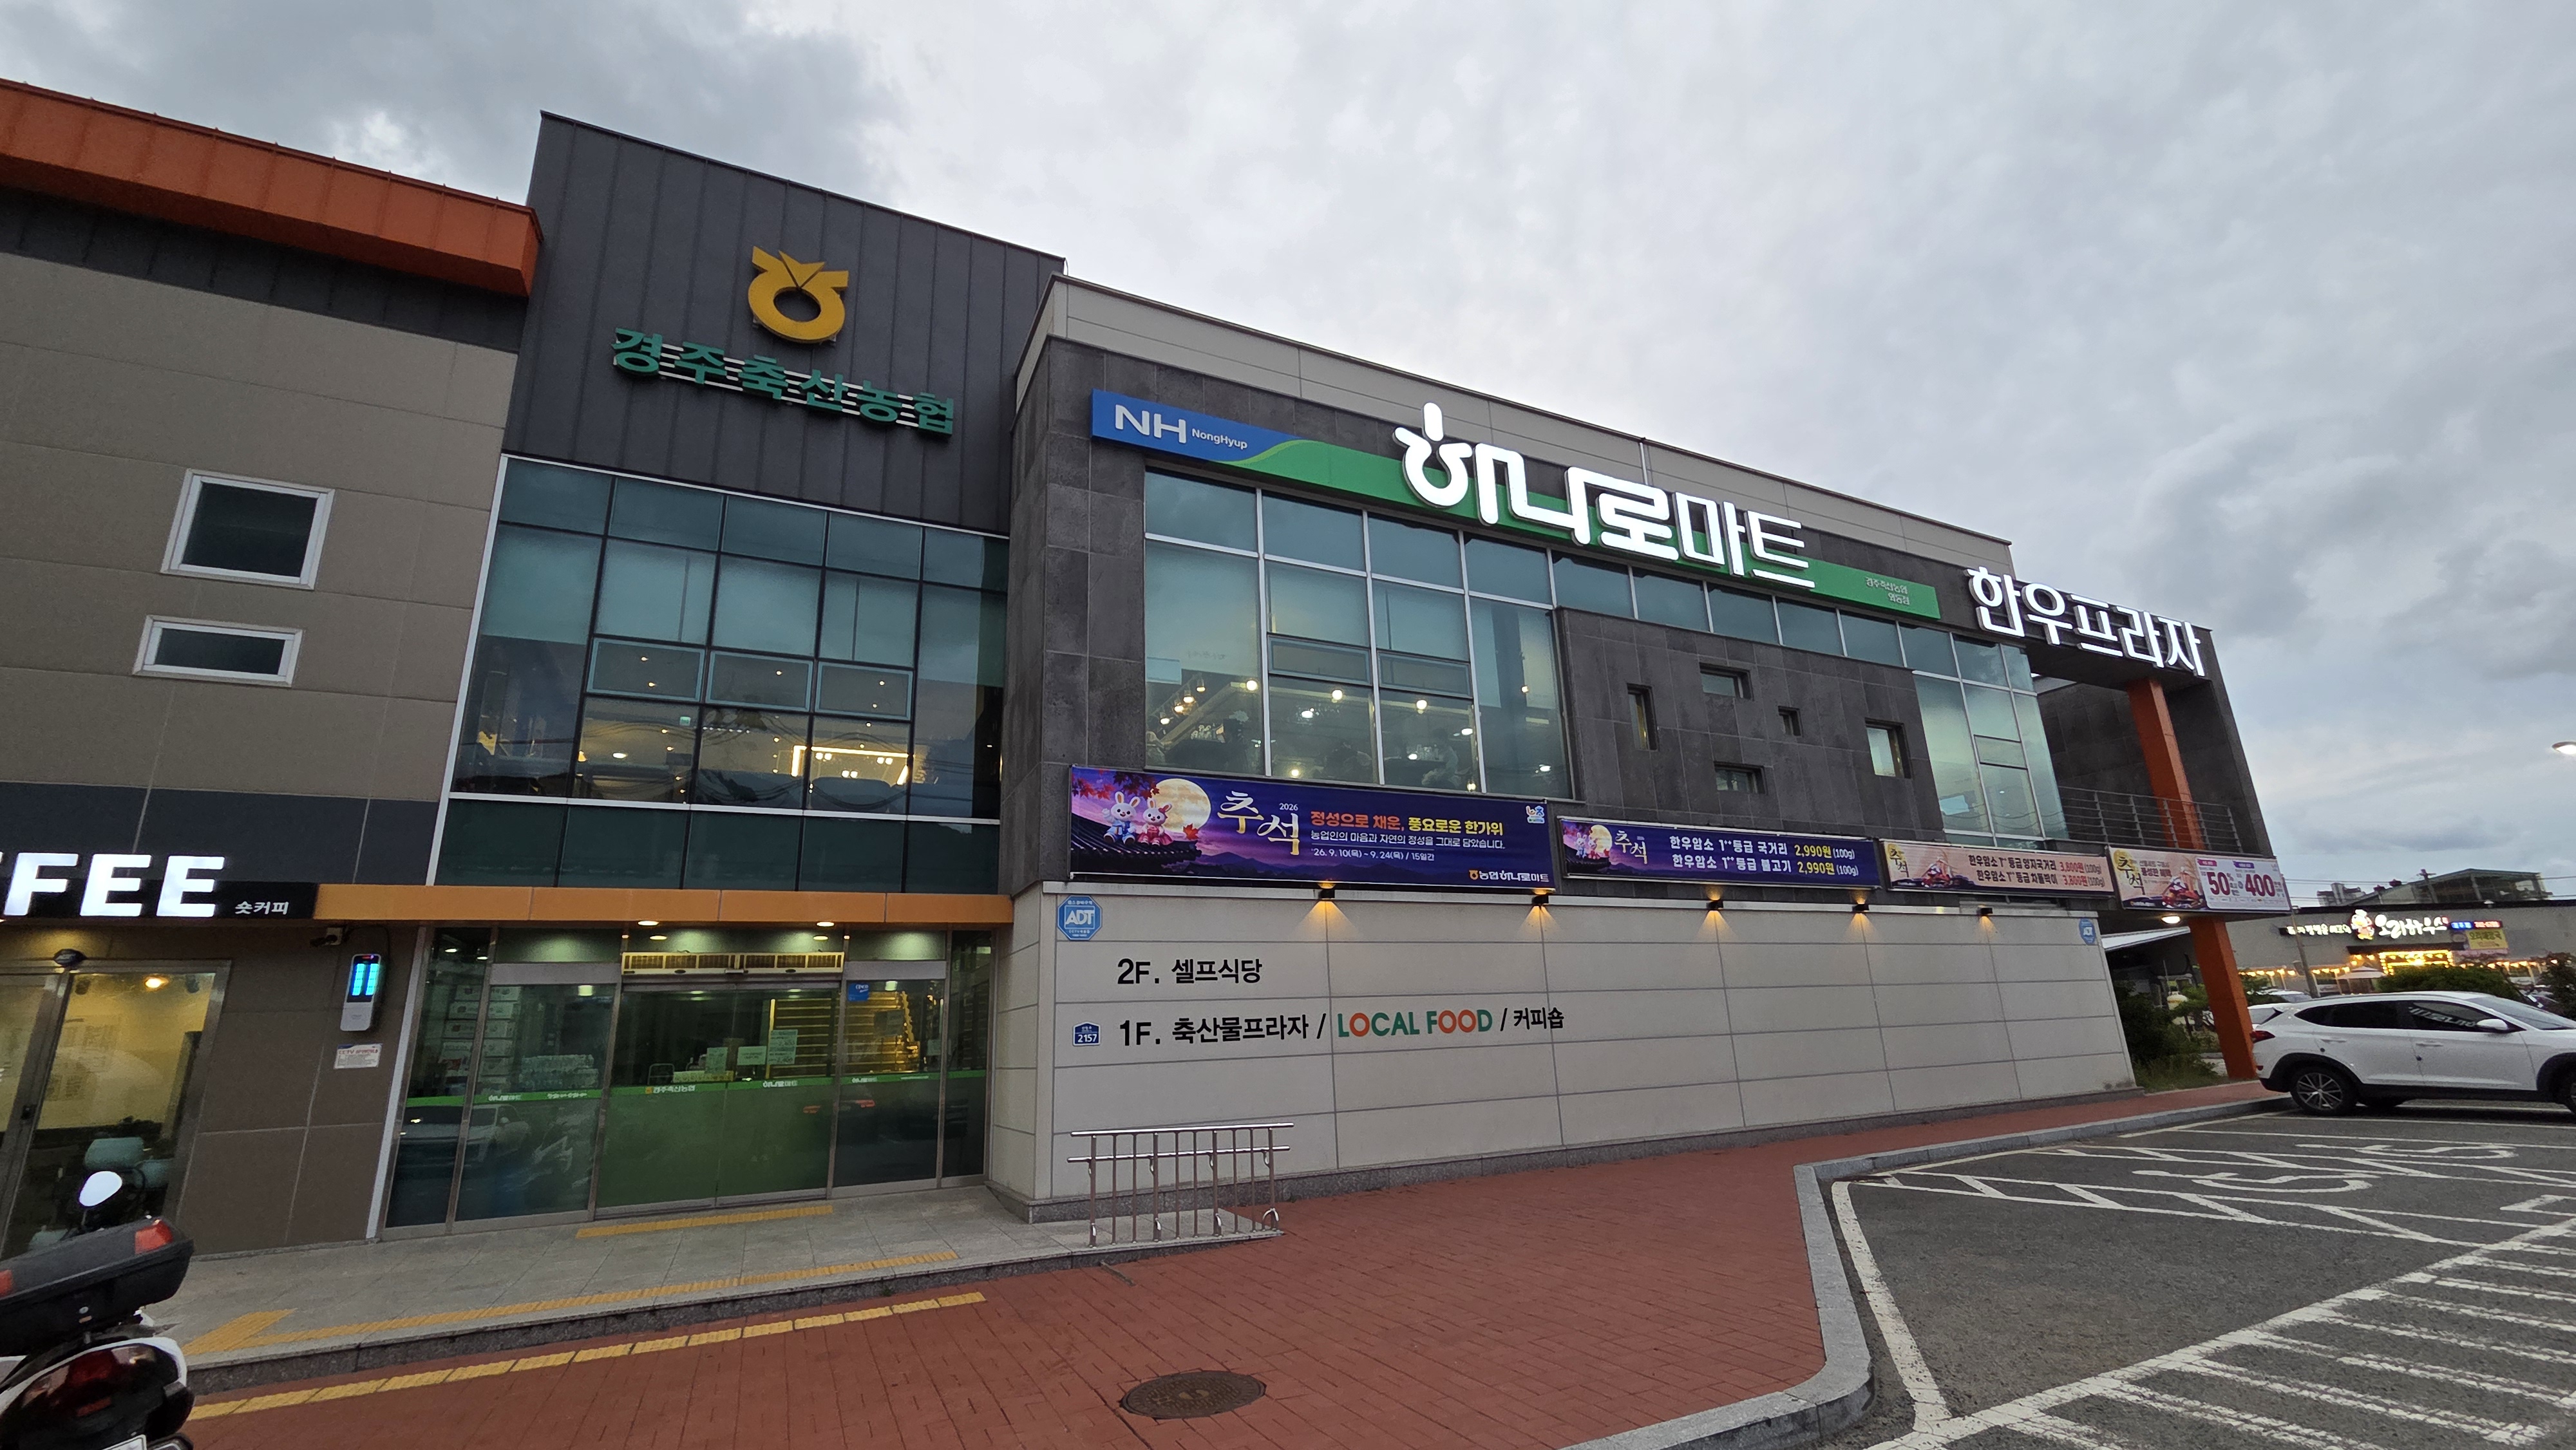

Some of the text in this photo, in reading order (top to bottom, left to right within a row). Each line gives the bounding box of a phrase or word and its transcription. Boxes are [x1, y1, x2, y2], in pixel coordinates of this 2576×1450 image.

[611, 328, 954, 435] 경주축산농협
[1115, 404, 1247, 449] NH NongHyup
[1393, 402, 1816, 588] 하나로마트
[1964, 566, 2205, 677] 한우프라자
[1279, 802, 1298, 811] 2026
[1217, 790, 1300, 856] 추석
[1311, 811, 1503, 836] 정성으로 채운, 풍요로운 한가위
[1311, 830, 1506, 849] 농업인의 마음과 자연의 정성을 그대로 담았습니다.
[1615, 830, 1648, 864] 추석
[1669, 836, 1714, 851] 한우암소
[1757, 841, 1788, 855] 국거리
[1794, 844, 1832, 858] 2,990원
[1833, 848, 1855, 860] (100g)
[1411, 852, 1435, 862] 15일간
[1672, 854, 1717, 869] 한우암소
[1761, 859, 1792, 872] 불고기
[1797, 862, 1835, 875] 2,990원
[1837, 865, 1859, 876] (100g)
[1889, 849, 1909, 878] 추석
[1968, 855, 1998, 867] 한우암소
[0, 852, 225, 918] FEE
[1976, 870, 2006, 882] 한우암소
[2117, 856, 2145, 895] 추석
[2245, 874, 2275, 897] 400
[234, 901, 289, 916] 숏커피
[1065, 909, 1095, 925] ADT
[1117, 958, 1262, 984] 2F. 셀프식당
[1077, 1033, 1097, 1043] 2157
[1120, 1020, 1160, 1046] 1F.
[1172, 1014, 1309, 1044] 축산물프라자
[1338, 1012, 1420, 1037] LOCAL
[1426, 1010, 1493, 1035] FOOD
[1513, 1007, 1564, 1030] 커피숍
